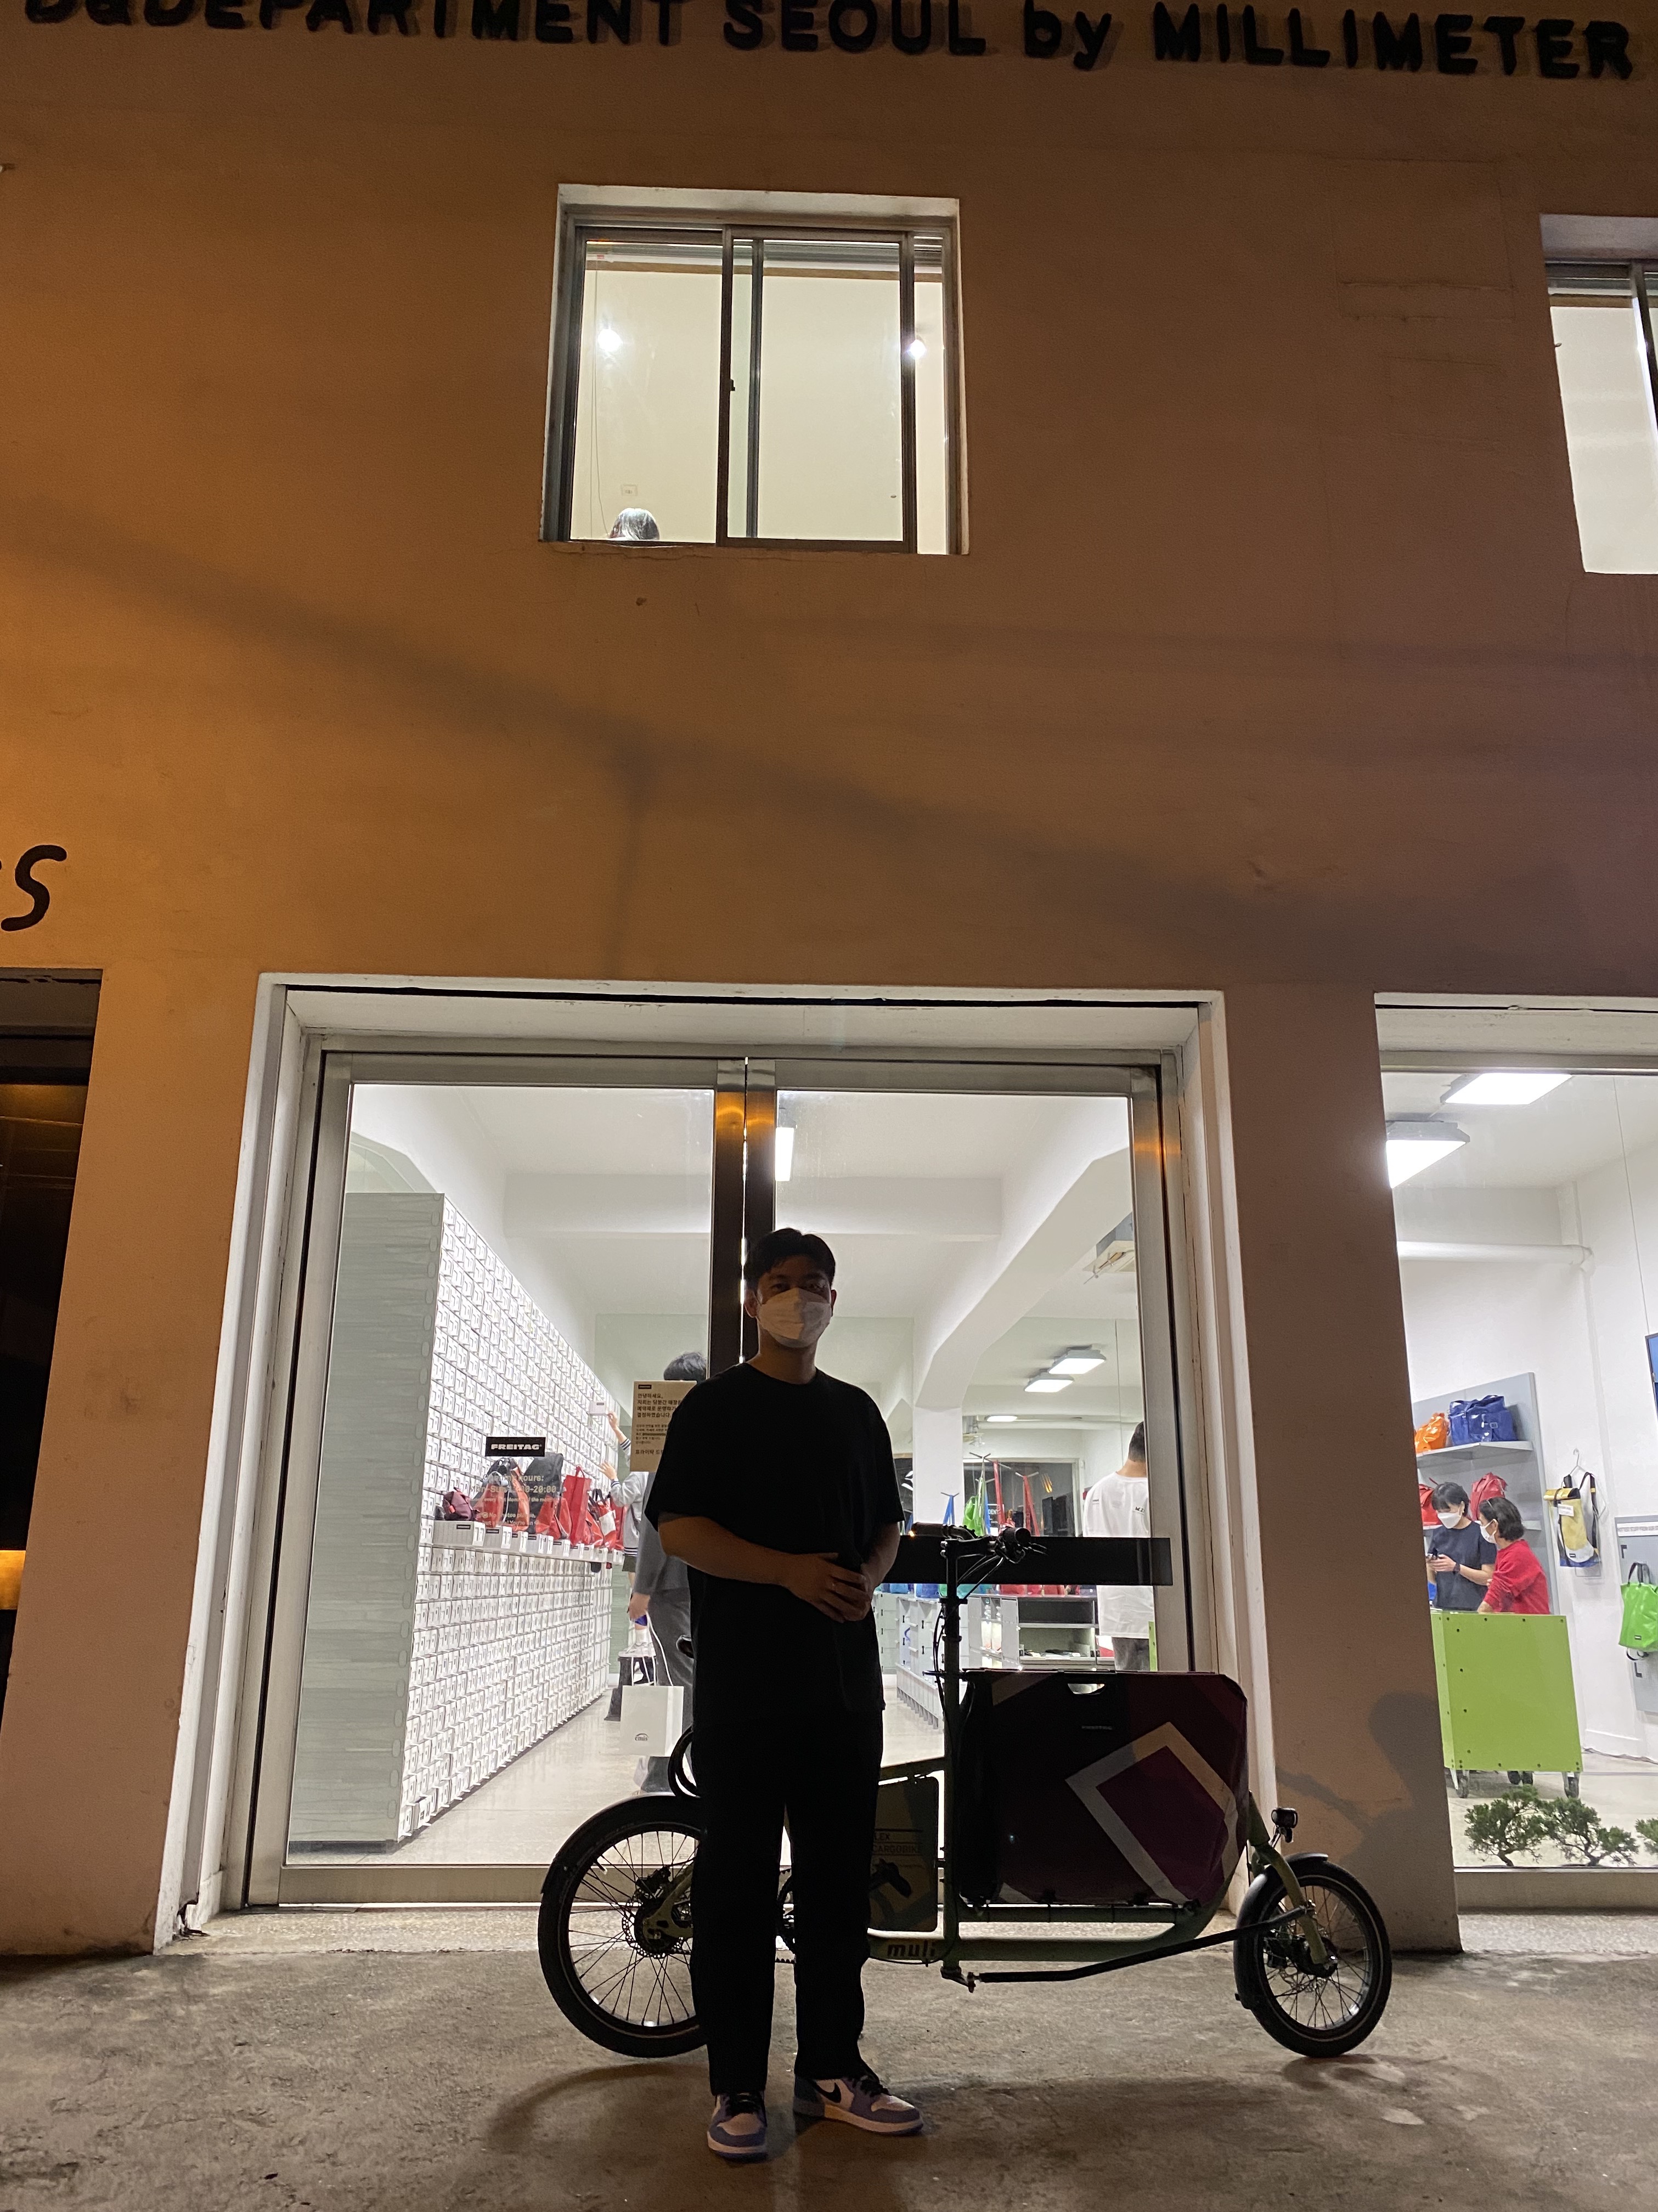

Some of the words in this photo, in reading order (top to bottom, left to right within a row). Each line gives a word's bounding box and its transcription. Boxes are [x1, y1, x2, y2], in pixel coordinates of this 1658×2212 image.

[724, 0, 986, 55] SEOUL
[1024, 0, 1112, 71] by
[1153, 1, 1634, 80] MILLIMETER
